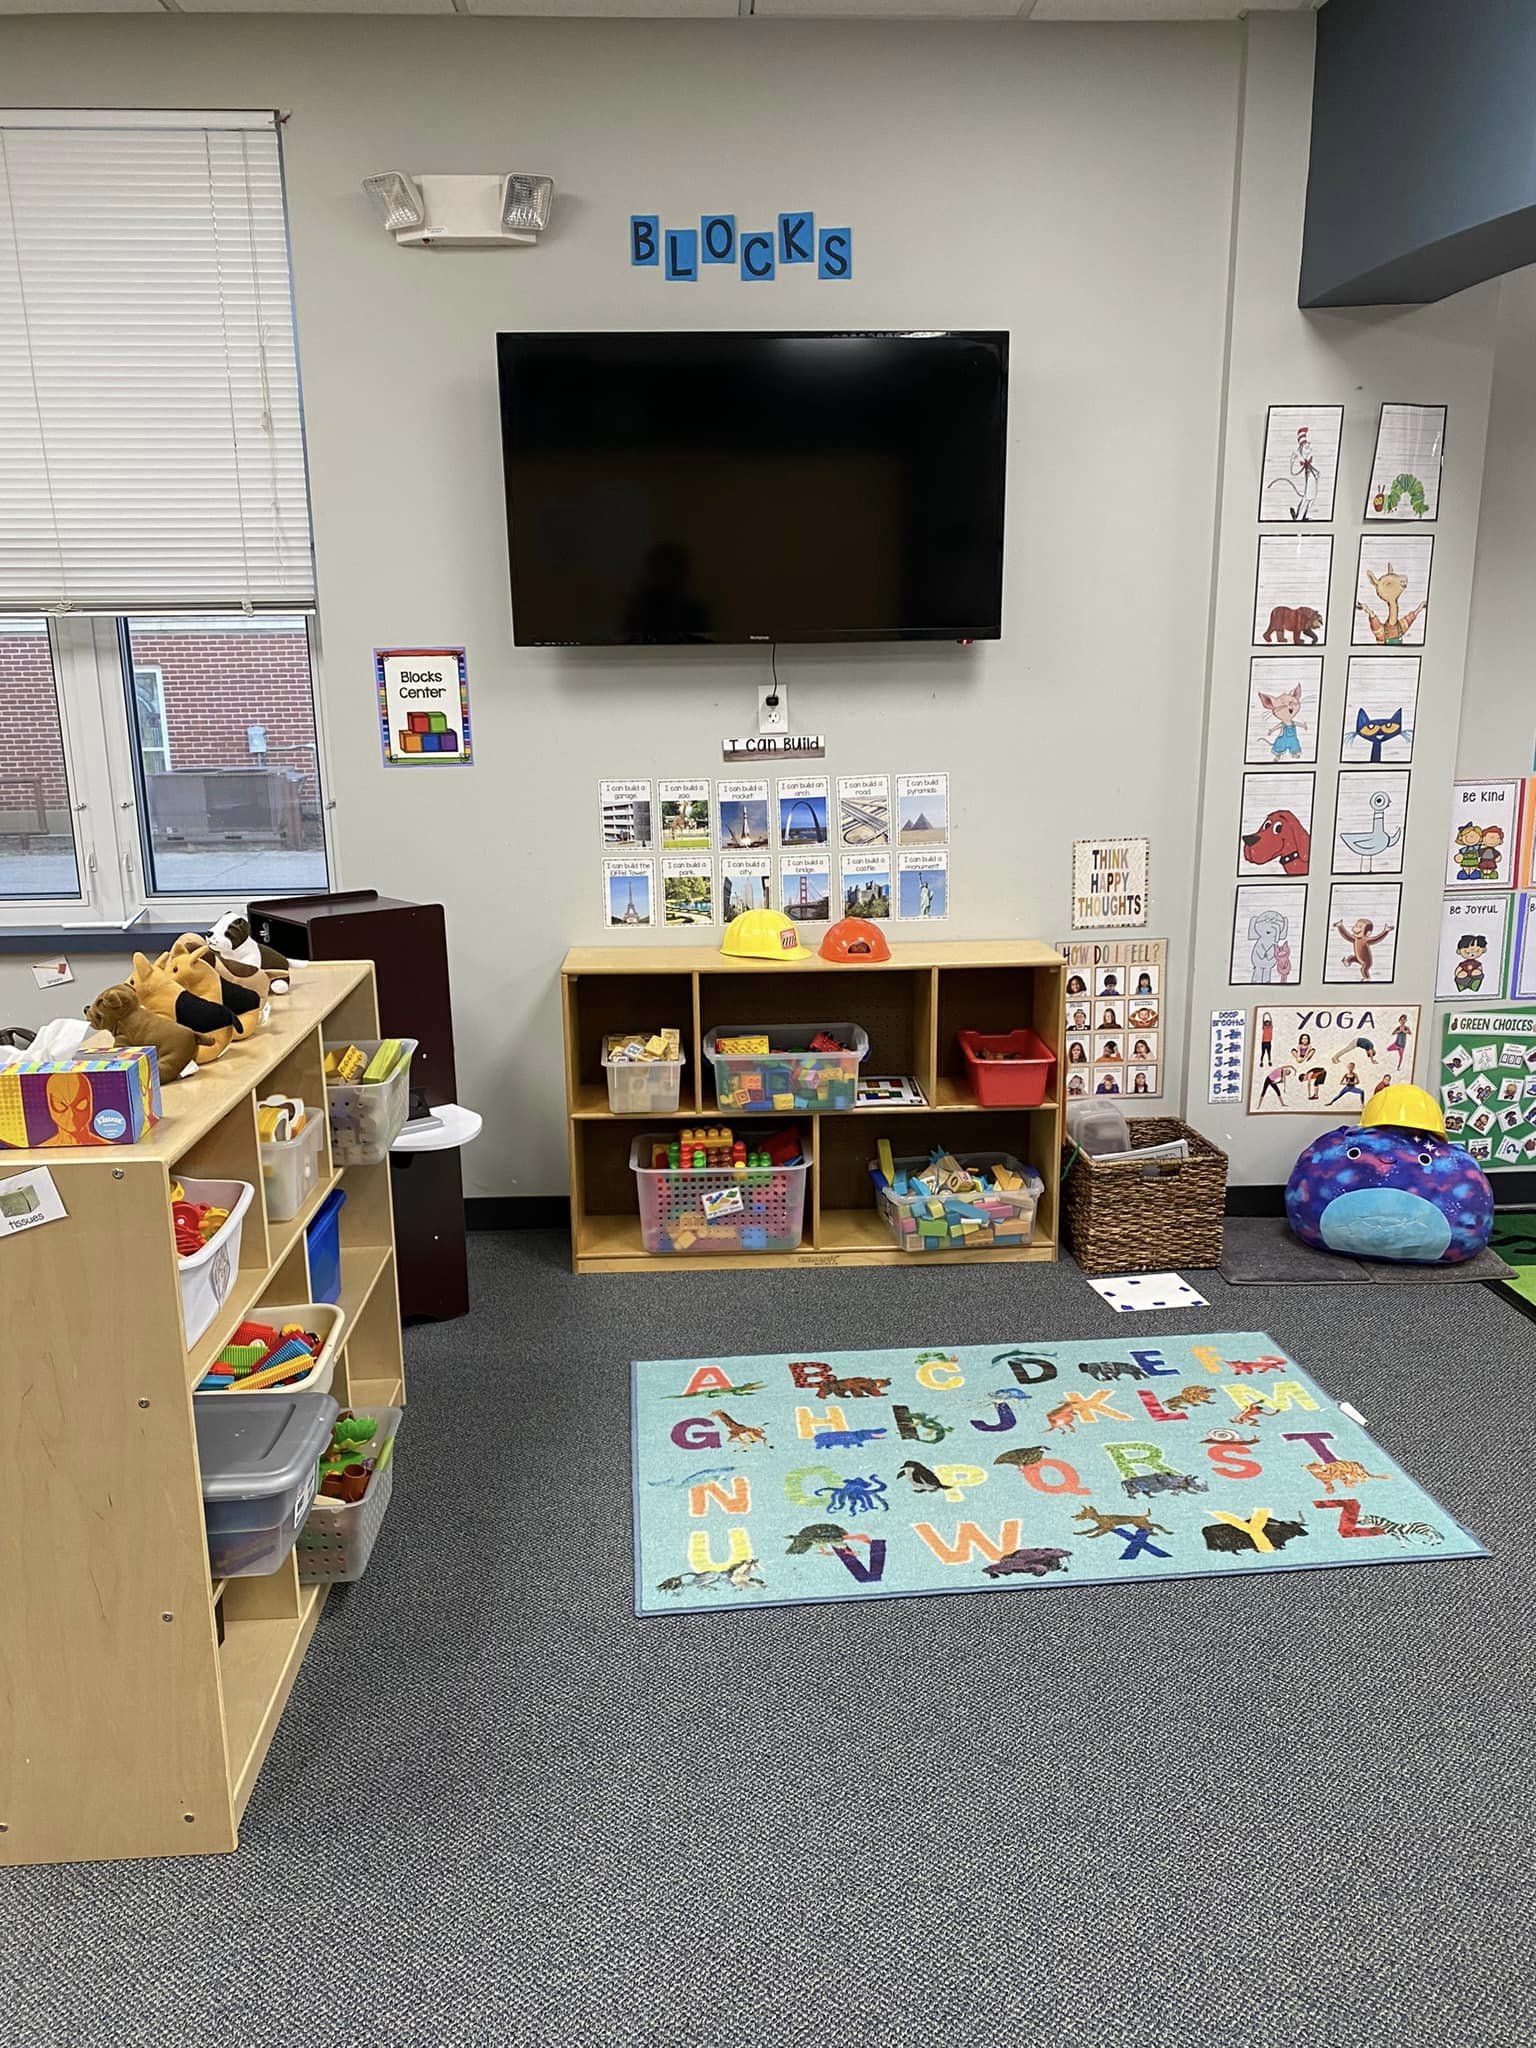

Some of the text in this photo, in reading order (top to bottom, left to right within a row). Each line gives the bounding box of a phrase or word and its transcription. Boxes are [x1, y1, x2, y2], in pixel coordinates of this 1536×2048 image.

[633, 218, 848, 277] BLOCKS
[400, 671, 443, 683] Blocks
[399, 686, 447, 698] Center
[729, 739, 739, 753] I
[745, 738, 777, 753] Can
[624, 784, 640, 792] build
[682, 784, 698, 792] build
[741, 784, 757, 792] build
[799, 781, 815, 789] build
[1463, 790, 1505, 803] Be Kind
[623, 861, 639, 869] build
[745, 860, 760, 868] build
[1091, 849, 1129, 870] THINK
[1090, 872, 1130, 894] HAPPY
[1077, 894, 1142, 918] THOUGHTS
[1449, 905, 1462, 915] Be
[1063, 943, 1161, 966] HOW DO I FEEL?
[1296, 1011, 1375, 1030] YOGA
[1460, 1018, 1534, 1032] GREEN CHOICES
[1215, 1029, 1222, 1041] 1
[1215, 1042, 1223, 1054] 2
[1214, 1056, 1223, 1067] 3
[1213, 1069, 1223, 1082] 4
[1213, 1083, 1222, 1095] 5
[8, 1212, 45, 1230] tissues
[683, 1345, 1223, 1397] A B C D E F
[669, 1416, 723, 1451] G
[794, 1404, 850, 1441] H
[969, 1401, 1018, 1433] J
[1062, 1388, 1135, 1424] K
[1136, 1389, 1189, 1423] L
[1220, 1380, 1321, 1413] M
[688, 1475, 752, 1518] N
[932, 1463, 989, 1502] P
[1020, 1457, 1092, 1496] Q
[1104, 1441, 1183, 1481] R
[1207, 1443, 1263, 1480] S
[1281, 1431, 1338, 1465] T
[687, 1498, 1386, 1584] U V W X Y Z
